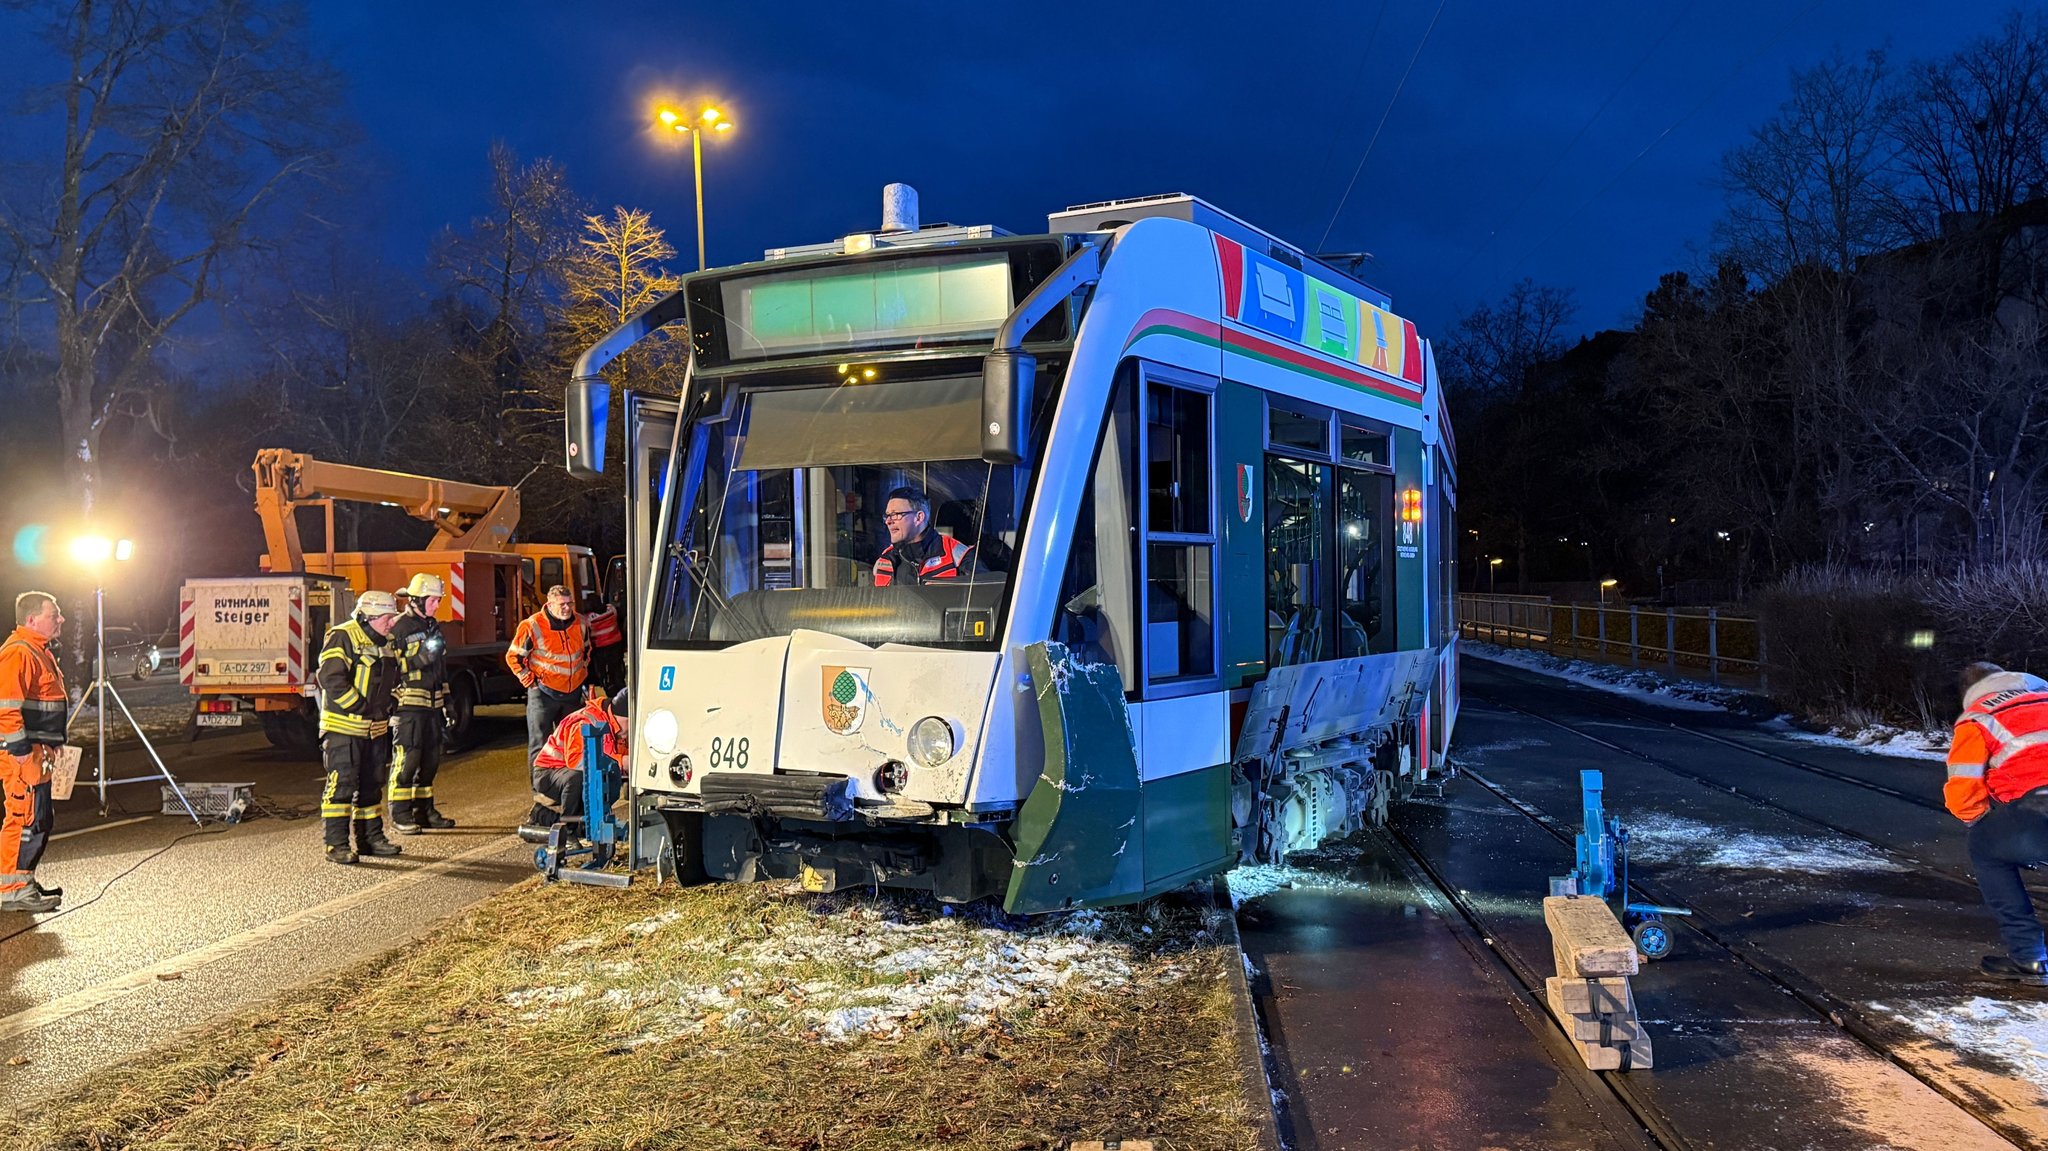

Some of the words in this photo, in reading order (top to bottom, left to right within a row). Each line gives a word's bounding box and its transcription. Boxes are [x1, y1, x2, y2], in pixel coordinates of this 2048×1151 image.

[214, 611, 270, 625] Steiger
[250, 663, 266, 673] 297
[709, 736, 750, 769] 848
